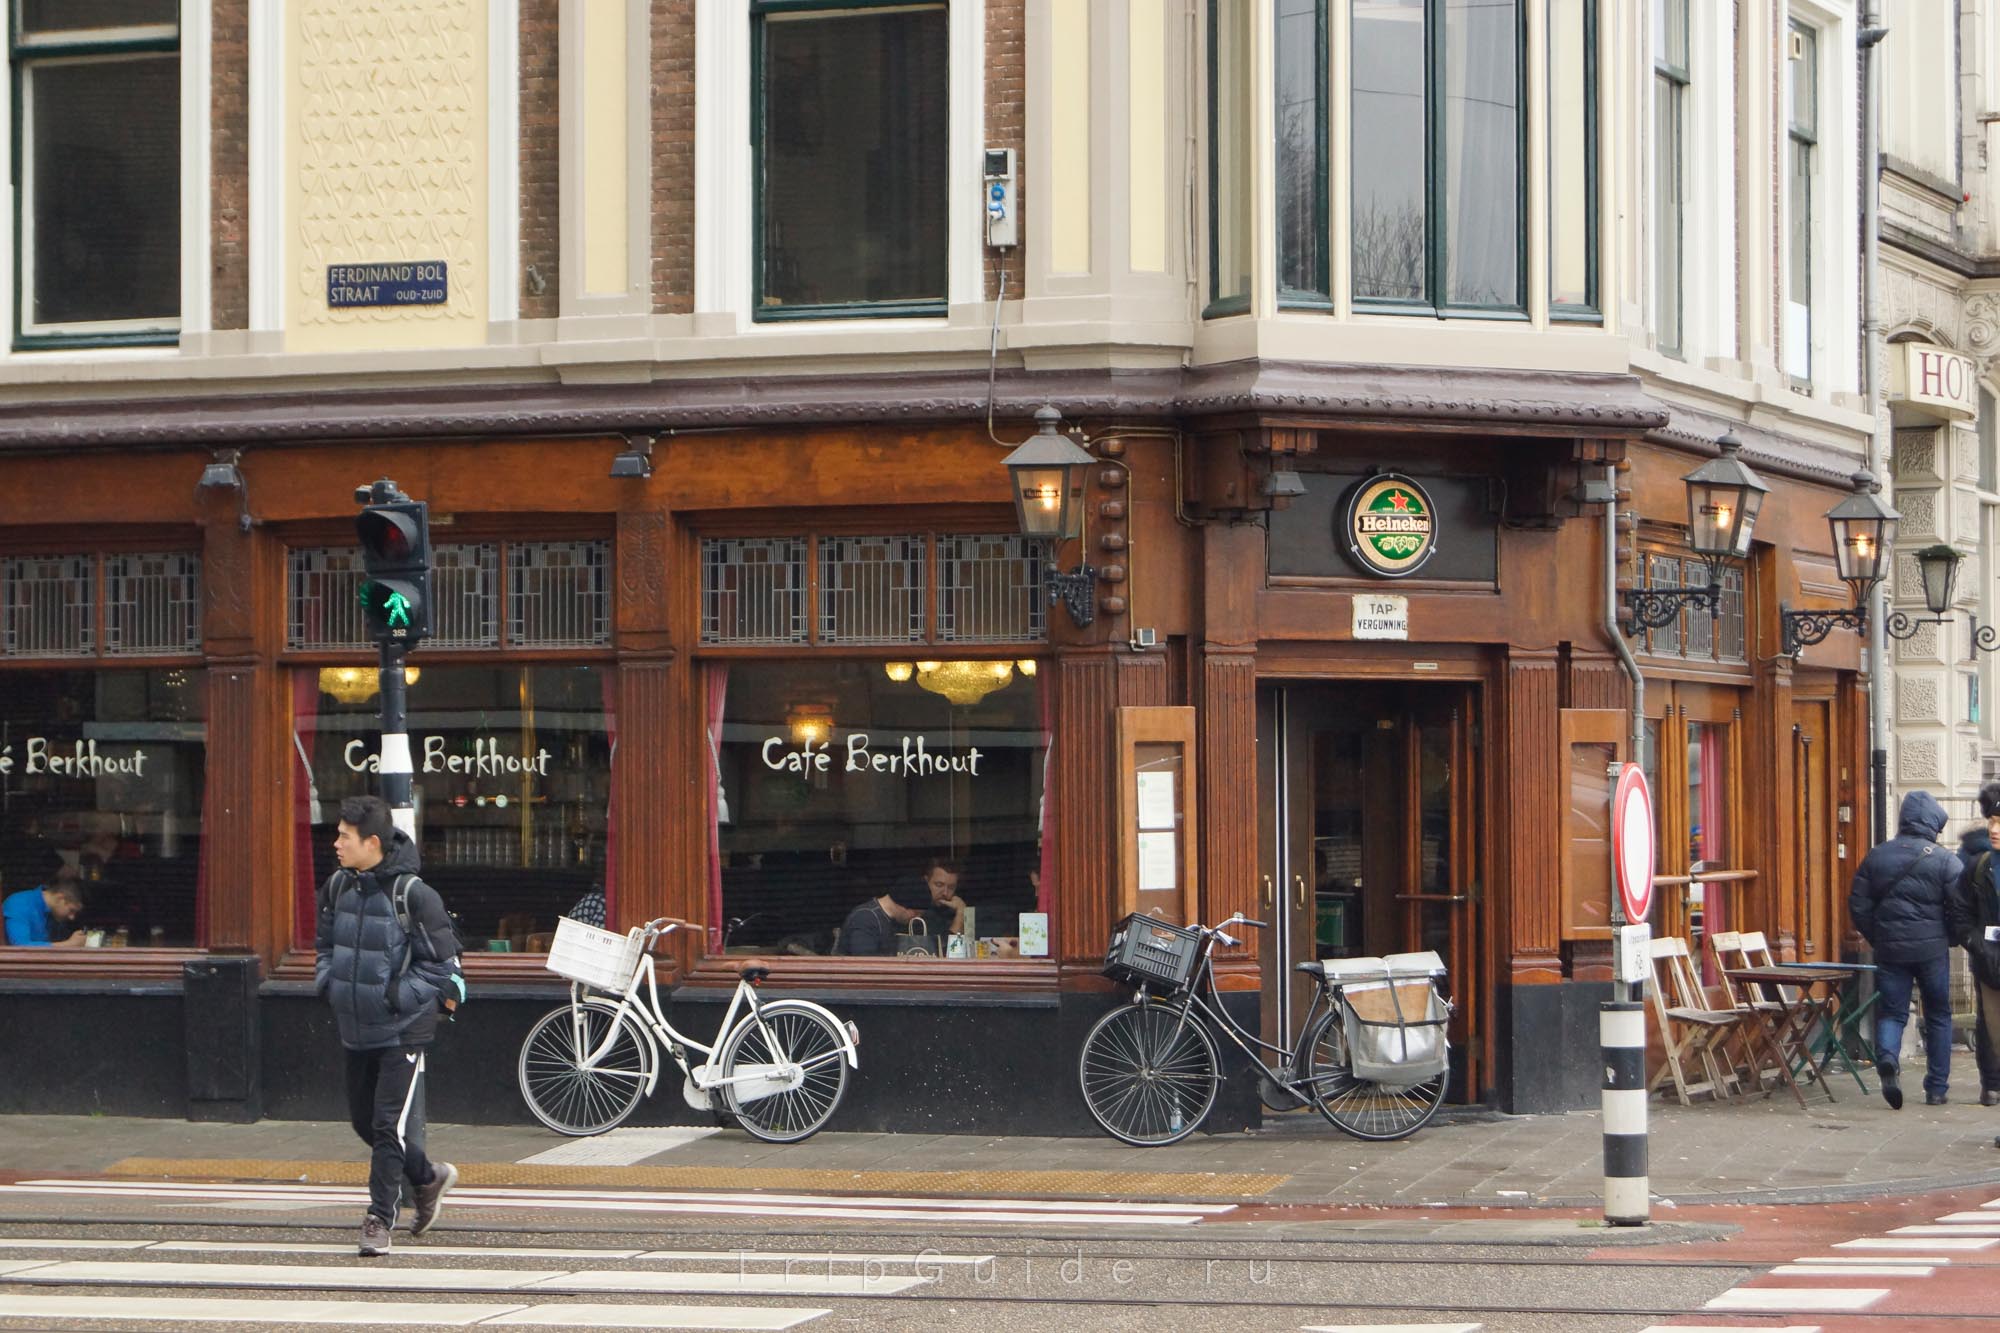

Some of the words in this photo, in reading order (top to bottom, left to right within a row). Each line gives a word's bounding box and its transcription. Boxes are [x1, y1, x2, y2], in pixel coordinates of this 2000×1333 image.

[417, 265, 443, 280] BOL
[331, 287, 379, 302] STRAAT
[396, 289, 443, 300] OUD-ZUID
[1362, 516, 1429, 531] Heineken
[1369, 603, 1397, 615] TAP-
[392, 628, 407, 637] 352
[1358, 619, 1407, 631] VERGUNNING
[26, 737, 148, 779] Berkhout
[423, 735, 552, 778] Berkhout
[762, 735, 831, 780] Café
[845, 733, 984, 778] Berkhout
